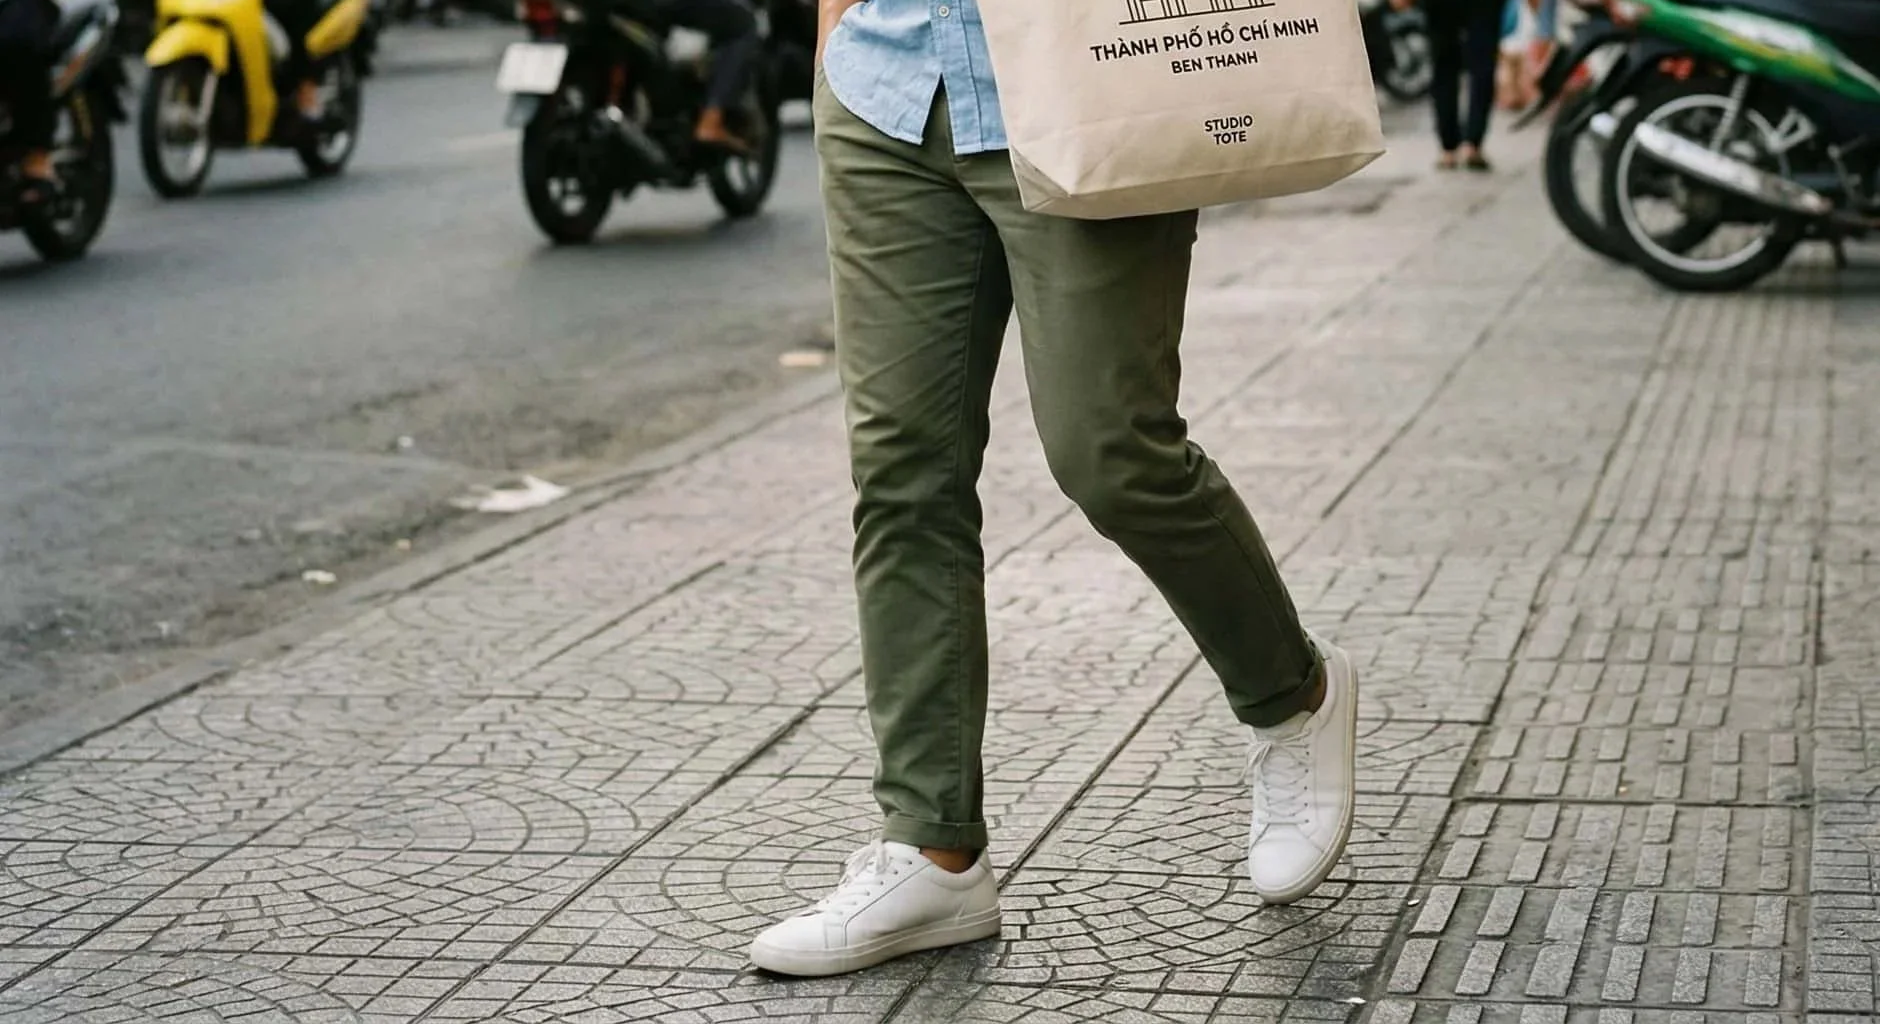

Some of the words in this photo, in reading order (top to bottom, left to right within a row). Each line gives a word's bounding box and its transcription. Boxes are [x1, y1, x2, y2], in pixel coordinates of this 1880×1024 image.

[1090, 37, 1159, 61] THÀNH
[1162, 25, 1204, 52] PHỐ
[1239, 20, 1269, 42] CHÍ
[1273, 18, 1320, 37] MINH
[1171, 58, 1203, 74] BEN
[1205, 51, 1258, 69] THANH
[1204, 115, 1253, 132] STUDIO
[1213, 130, 1247, 145] TOTE
